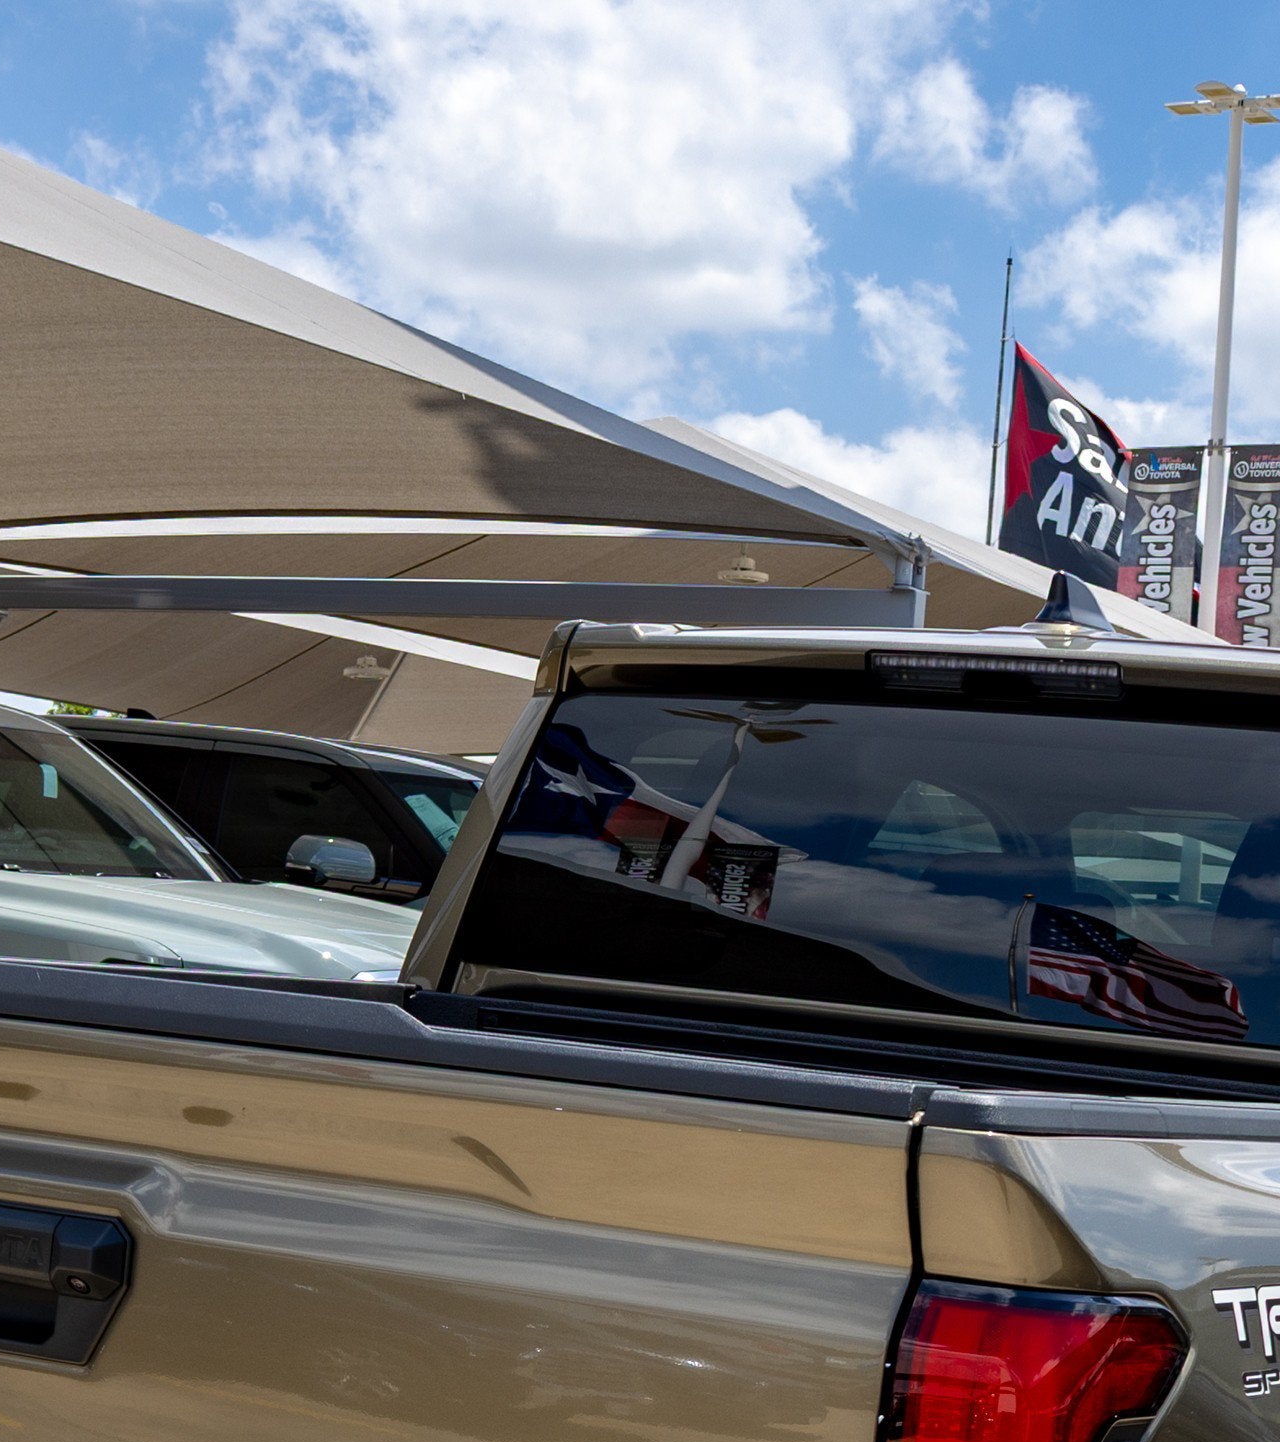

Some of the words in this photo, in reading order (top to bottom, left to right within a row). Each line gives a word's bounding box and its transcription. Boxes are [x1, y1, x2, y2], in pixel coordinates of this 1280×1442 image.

[1047, 398, 1129, 494] Sa
[1149, 471, 1181, 479] TOYOTA
[1250, 469, 1280, 477] TOYOTA
[1037, 471, 1125, 557] An
[1236, 503, 1277, 619] Vehicles
